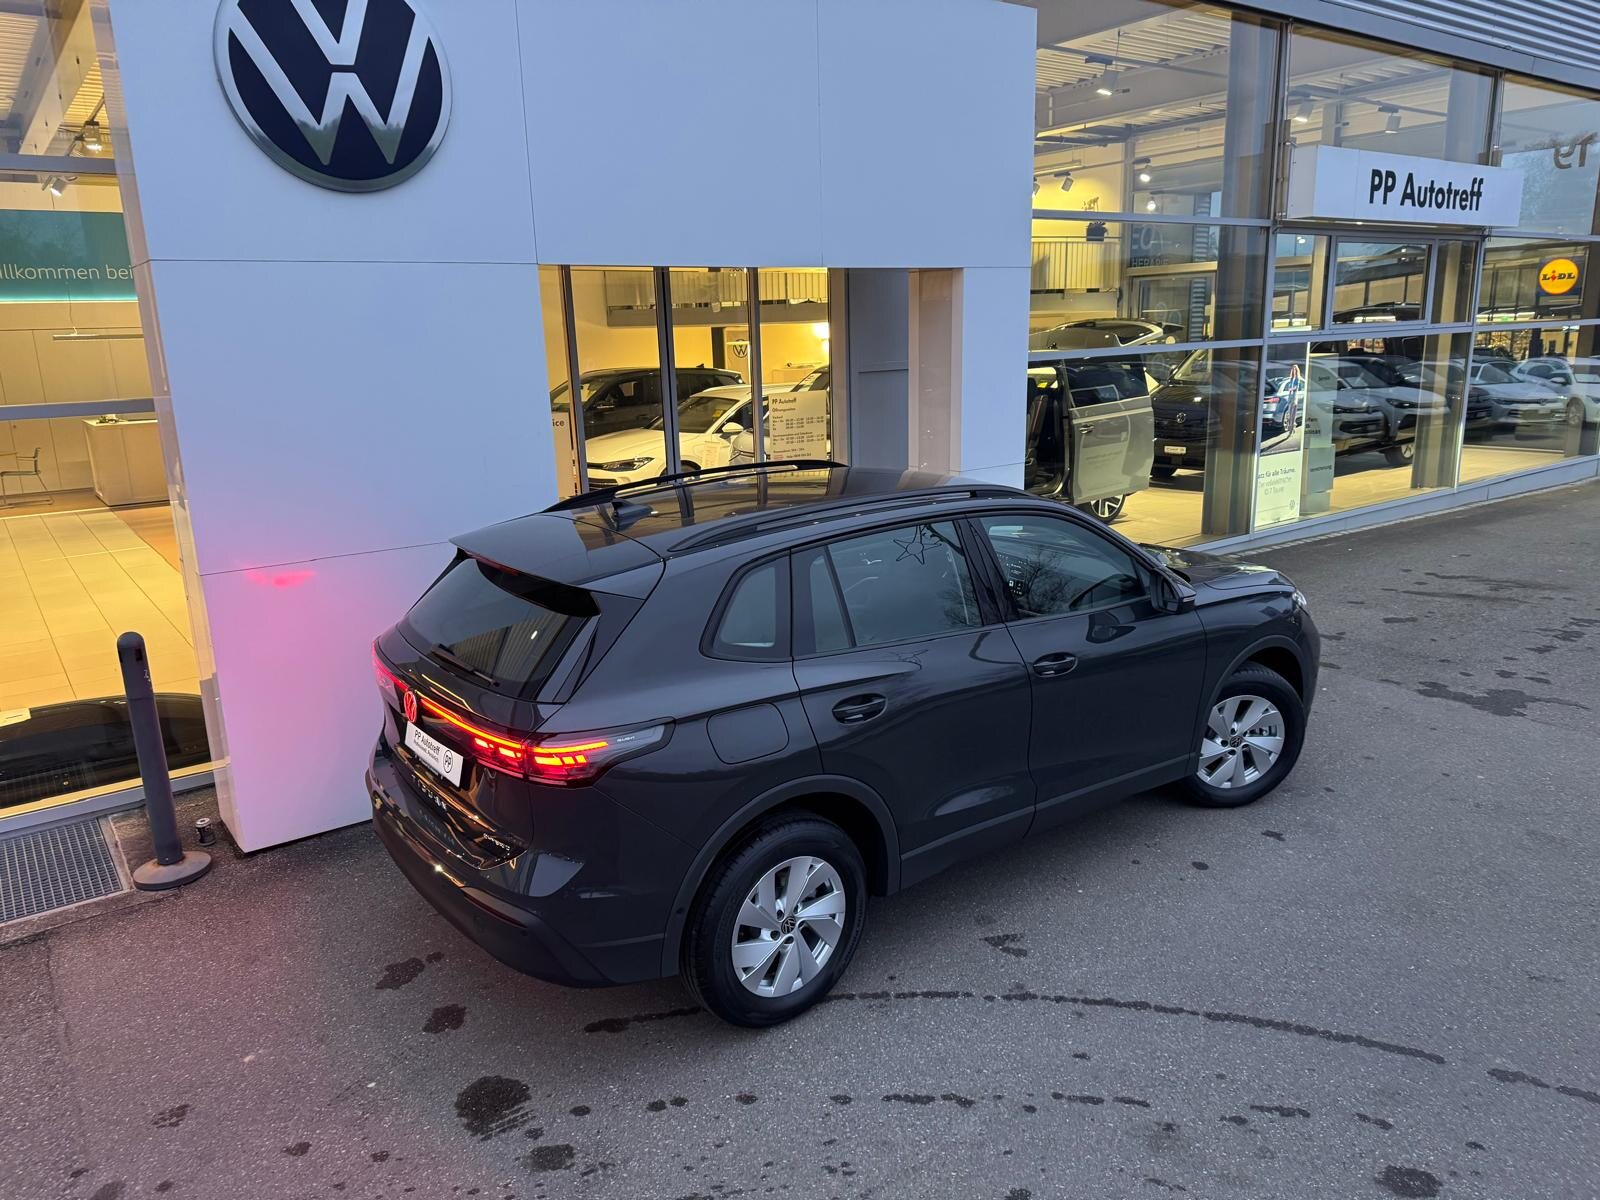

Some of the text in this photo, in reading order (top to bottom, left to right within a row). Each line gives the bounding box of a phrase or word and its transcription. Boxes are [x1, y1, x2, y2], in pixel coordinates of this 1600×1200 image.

[1369, 168, 1484, 211] PP Autotreff
[105, 263, 135, 280] bei
[414, 729, 422, 741] PP
